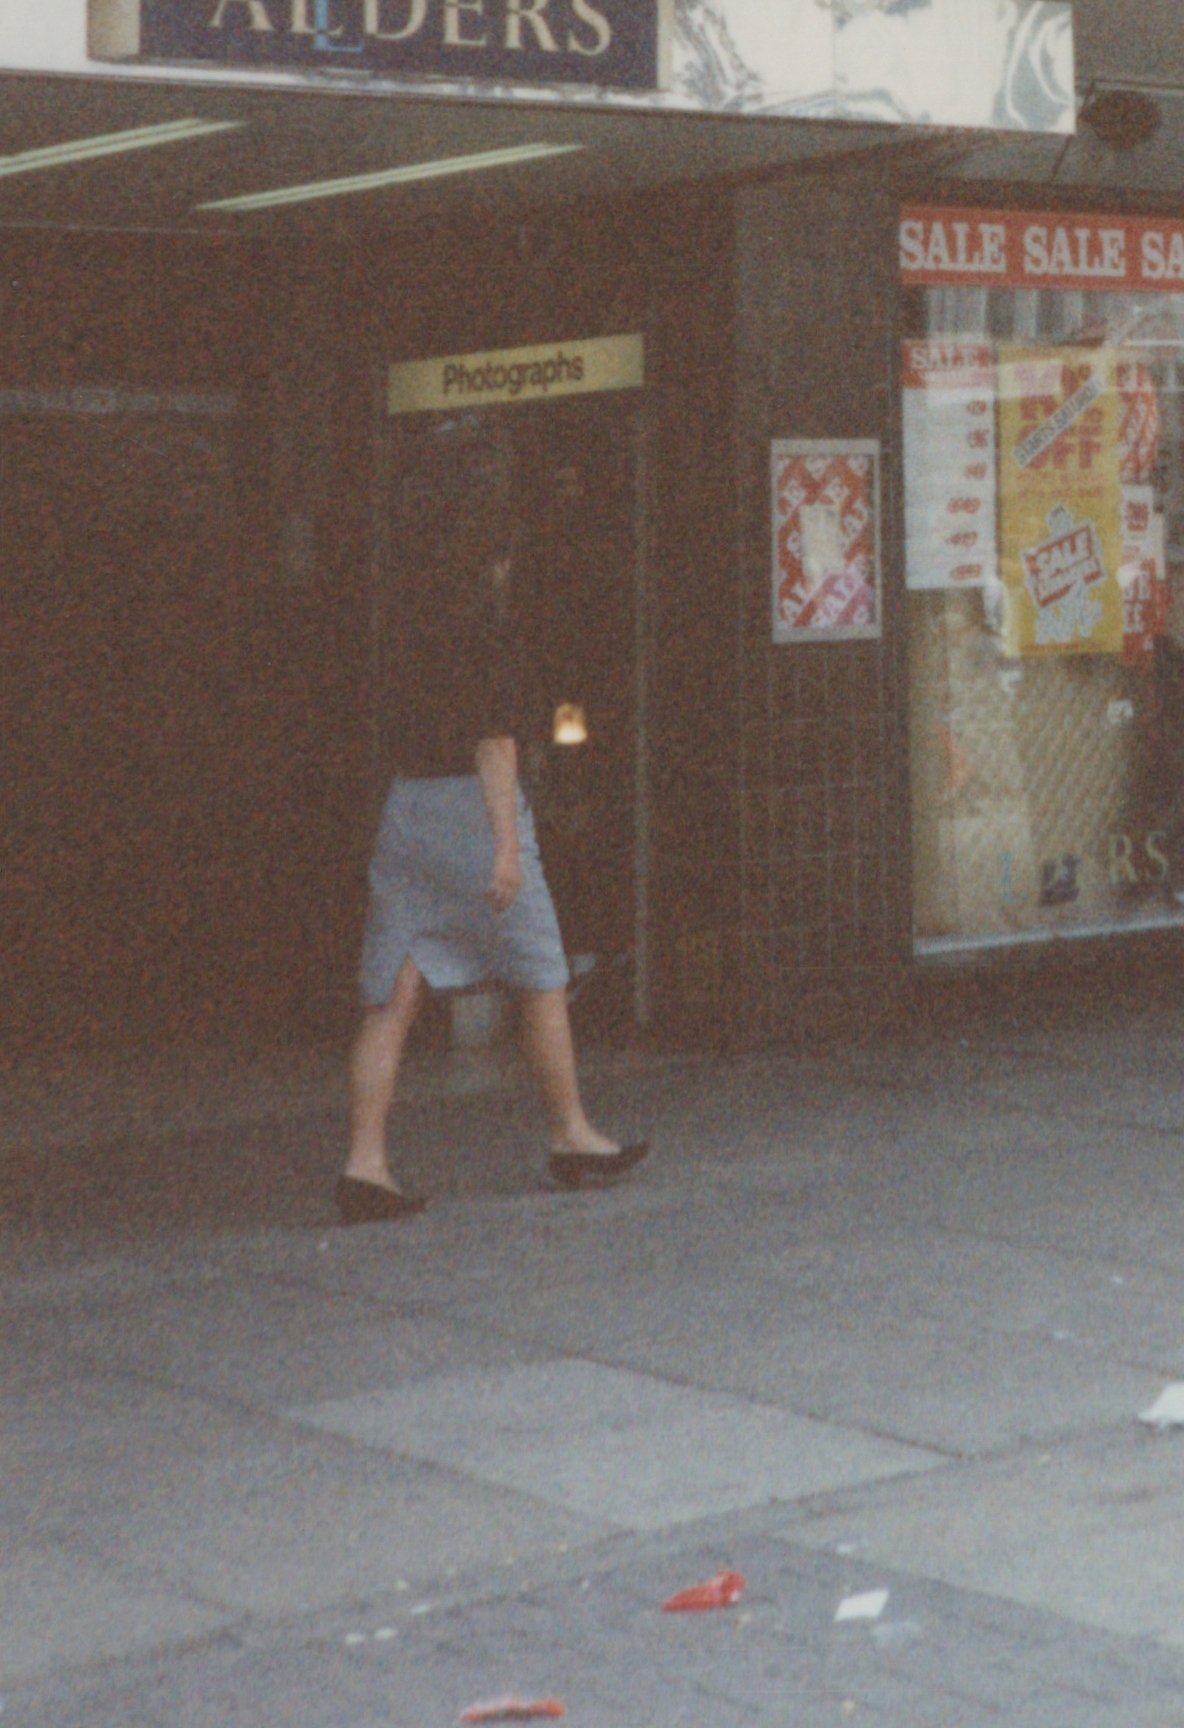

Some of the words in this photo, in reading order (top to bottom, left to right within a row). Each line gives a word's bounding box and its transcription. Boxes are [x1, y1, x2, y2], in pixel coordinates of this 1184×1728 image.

[900, 220, 1006, 272] SALE
[1023, 225, 1125, 277] SALE
[443, 351, 584, 395] Photographs
[1035, 528, 1090, 576] SALE
